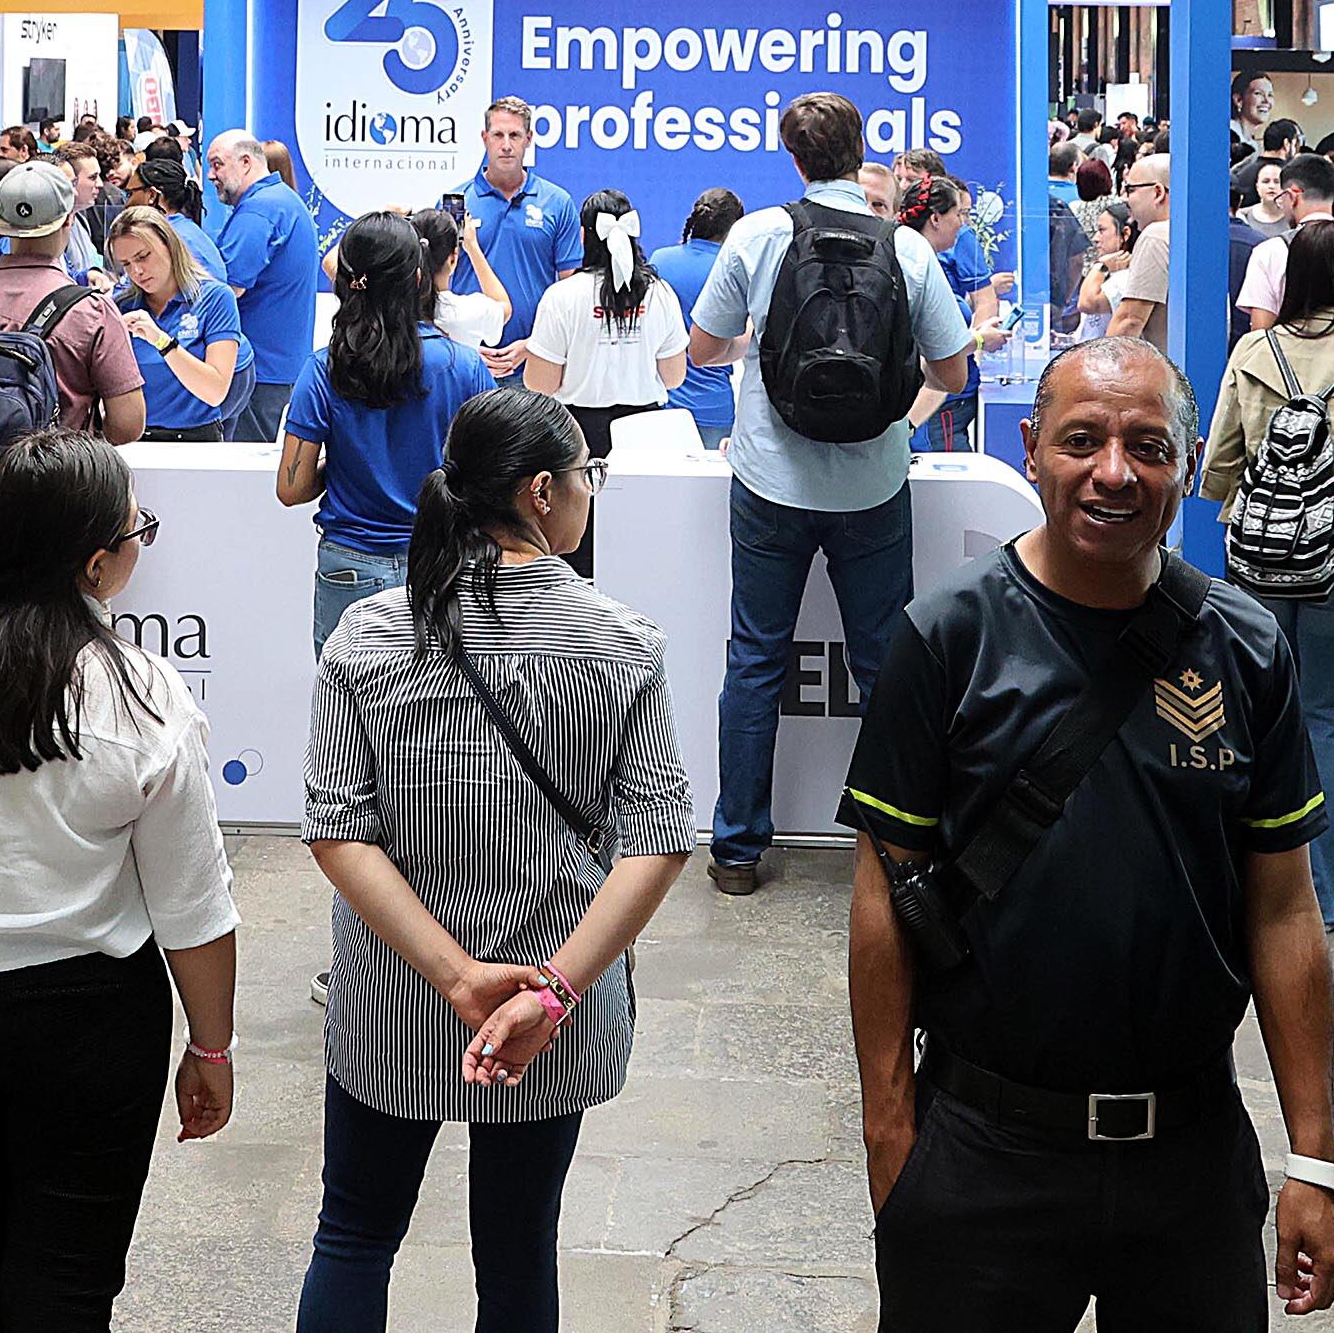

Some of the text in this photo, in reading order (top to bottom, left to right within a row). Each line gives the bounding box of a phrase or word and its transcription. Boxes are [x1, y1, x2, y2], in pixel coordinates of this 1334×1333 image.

[20, 16, 57, 44] stryker
[521, 12, 929, 93] Empowering
[437, 6, 474, 105] Anniversary
[325, 100, 458, 145] idioma
[528, 90, 963, 167] professials
[324, 154, 455, 171] internacional
[1169, 743, 1235, 771] I.S.P
